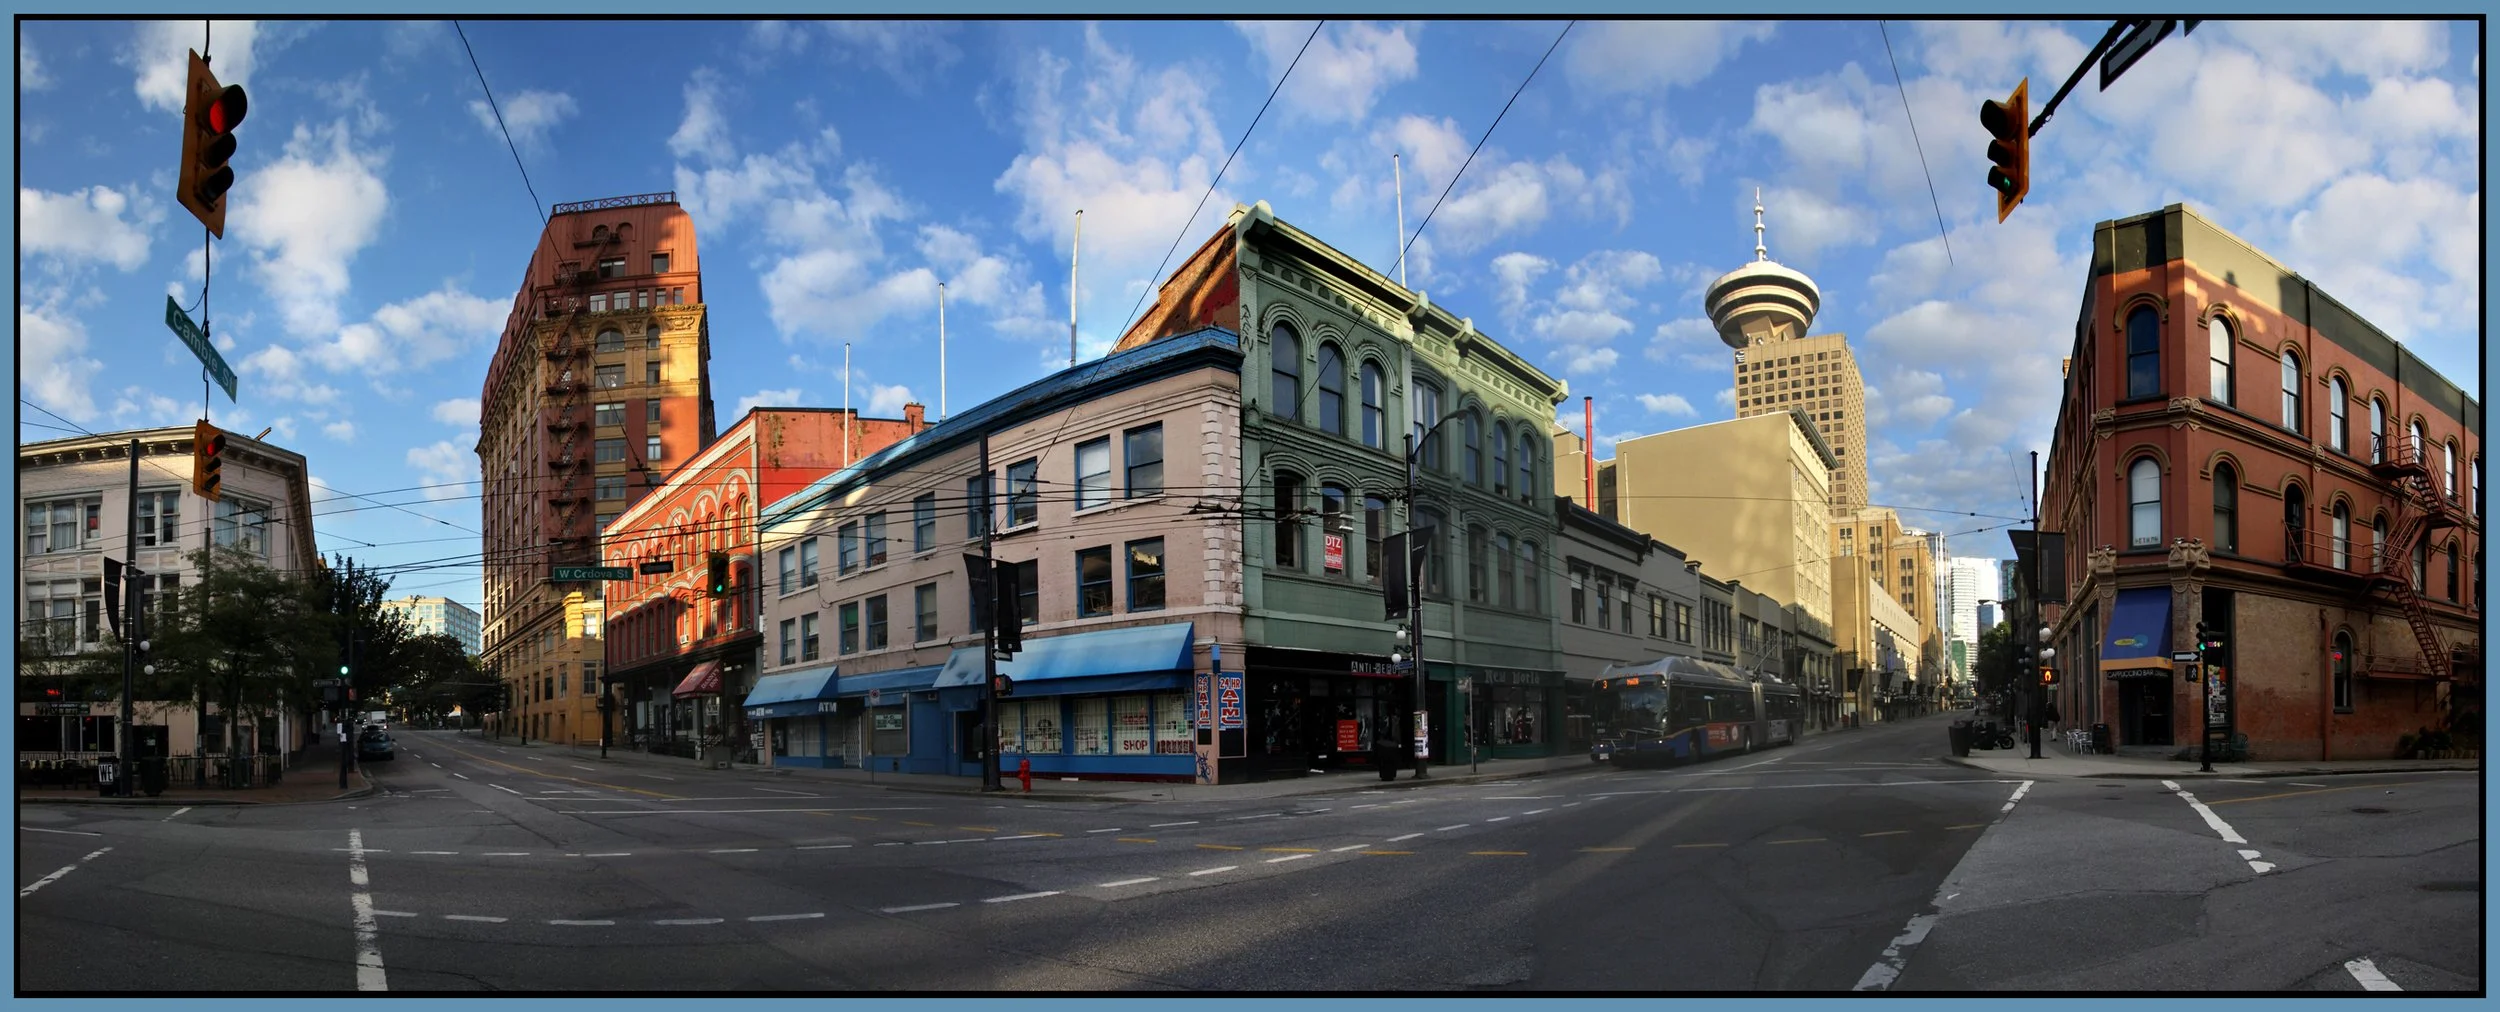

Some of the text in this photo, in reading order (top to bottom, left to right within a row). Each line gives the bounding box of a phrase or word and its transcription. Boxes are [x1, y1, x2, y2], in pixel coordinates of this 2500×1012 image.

[173, 310, 234, 393] Cambie St
[1325, 535, 1341, 548] DTZ
[559, 569, 570, 578] W
[616, 569, 628, 579] St
[2107, 669, 2142, 679] CAPPUCCINO
[1198, 677, 1208, 685] 24
[1220, 678, 1241, 689] 24 HR
[1602, 680, 1608, 689] 3
[818, 702, 837, 712] ATM
[1199, 693, 1209, 719] ATM
[1221, 689, 1240, 717] ATM
[1123, 740, 1148, 751] SHOP
[99, 764, 114, 783] WE
